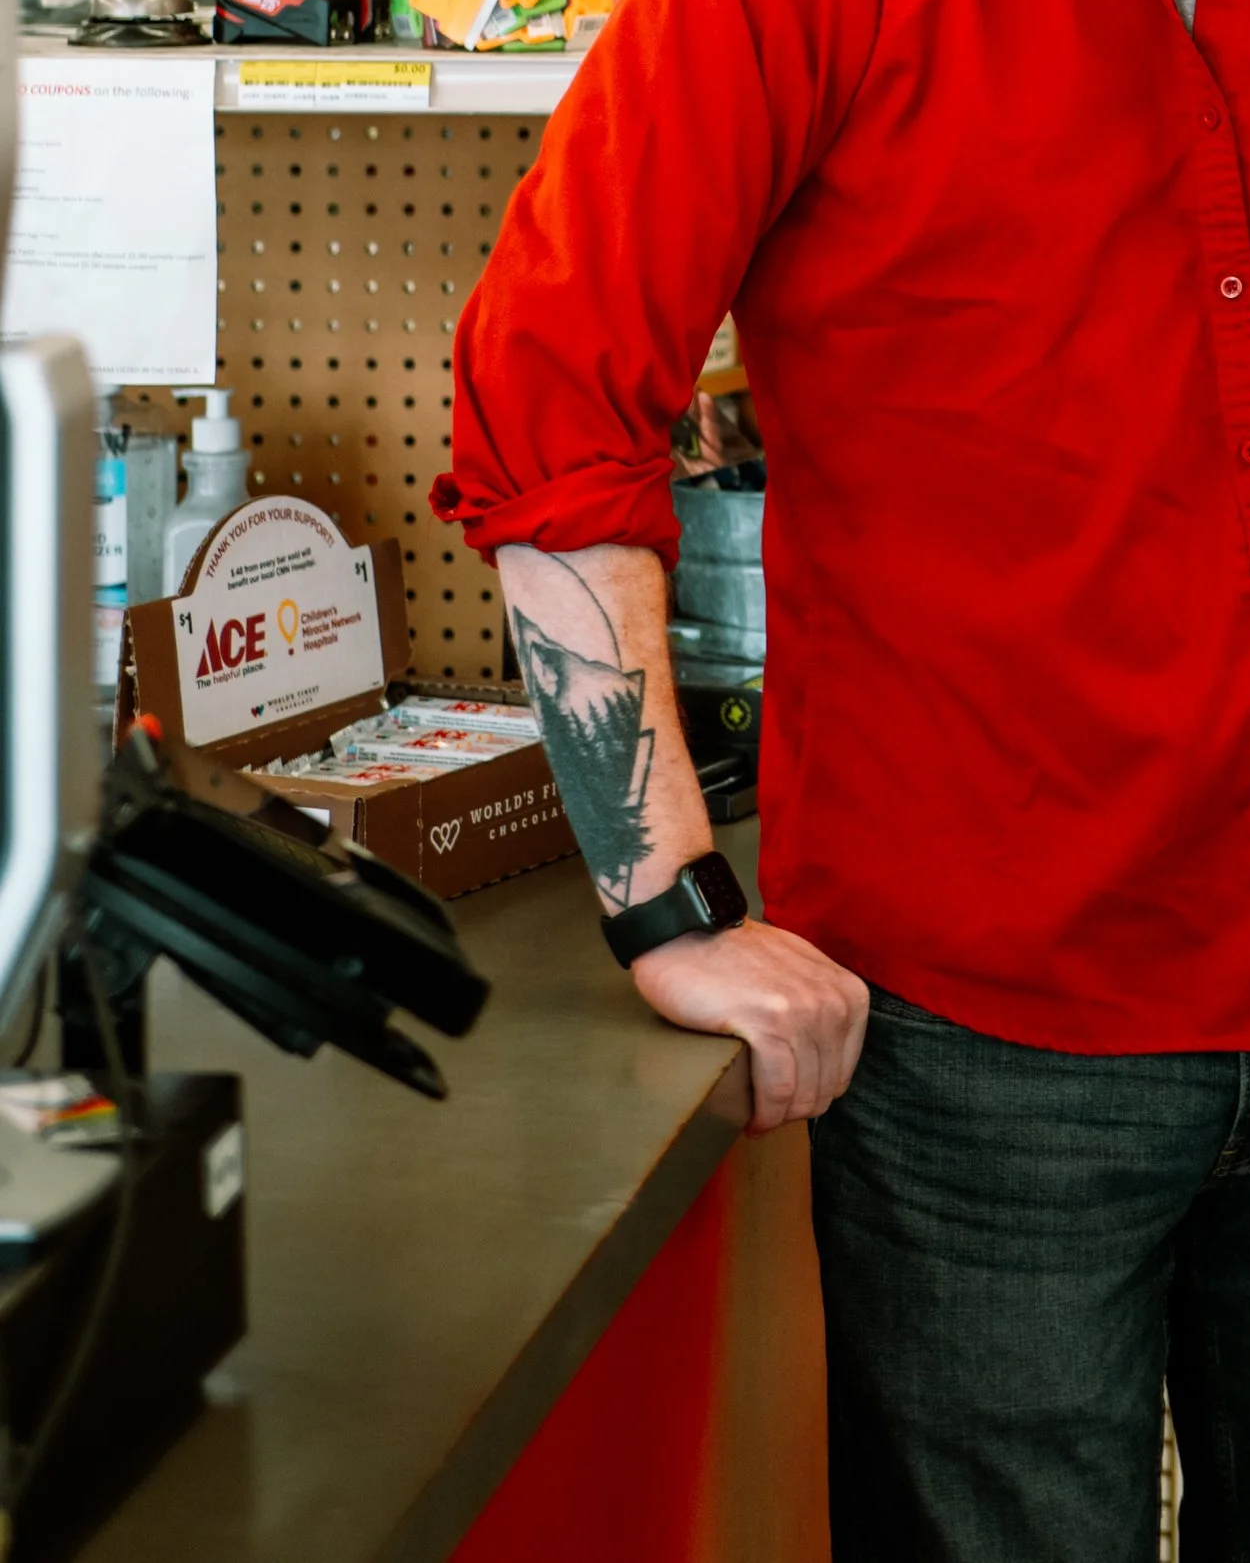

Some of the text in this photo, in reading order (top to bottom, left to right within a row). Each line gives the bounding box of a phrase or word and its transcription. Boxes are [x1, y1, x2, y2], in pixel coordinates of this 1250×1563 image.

[394, 64, 426, 75] $0.00
[30, 83, 91, 96] COUPONS
[94, 88, 109, 97] on
[112, 86, 131, 98] the
[205, 508, 335, 579] THANK YOU FOR YOUR SUPPORT!
[355, 560, 368, 583] $1
[179, 611, 193, 634] $1
[301, 605, 338, 624] Children's
[303, 612, 362, 638] Miracle Network
[196, 613, 266, 678] ACE
[304, 633, 338, 651] Hospitals
[196, 677, 211, 690] The
[213, 669, 241, 685] helpful
[470, 790, 534, 825] WORLD'S
